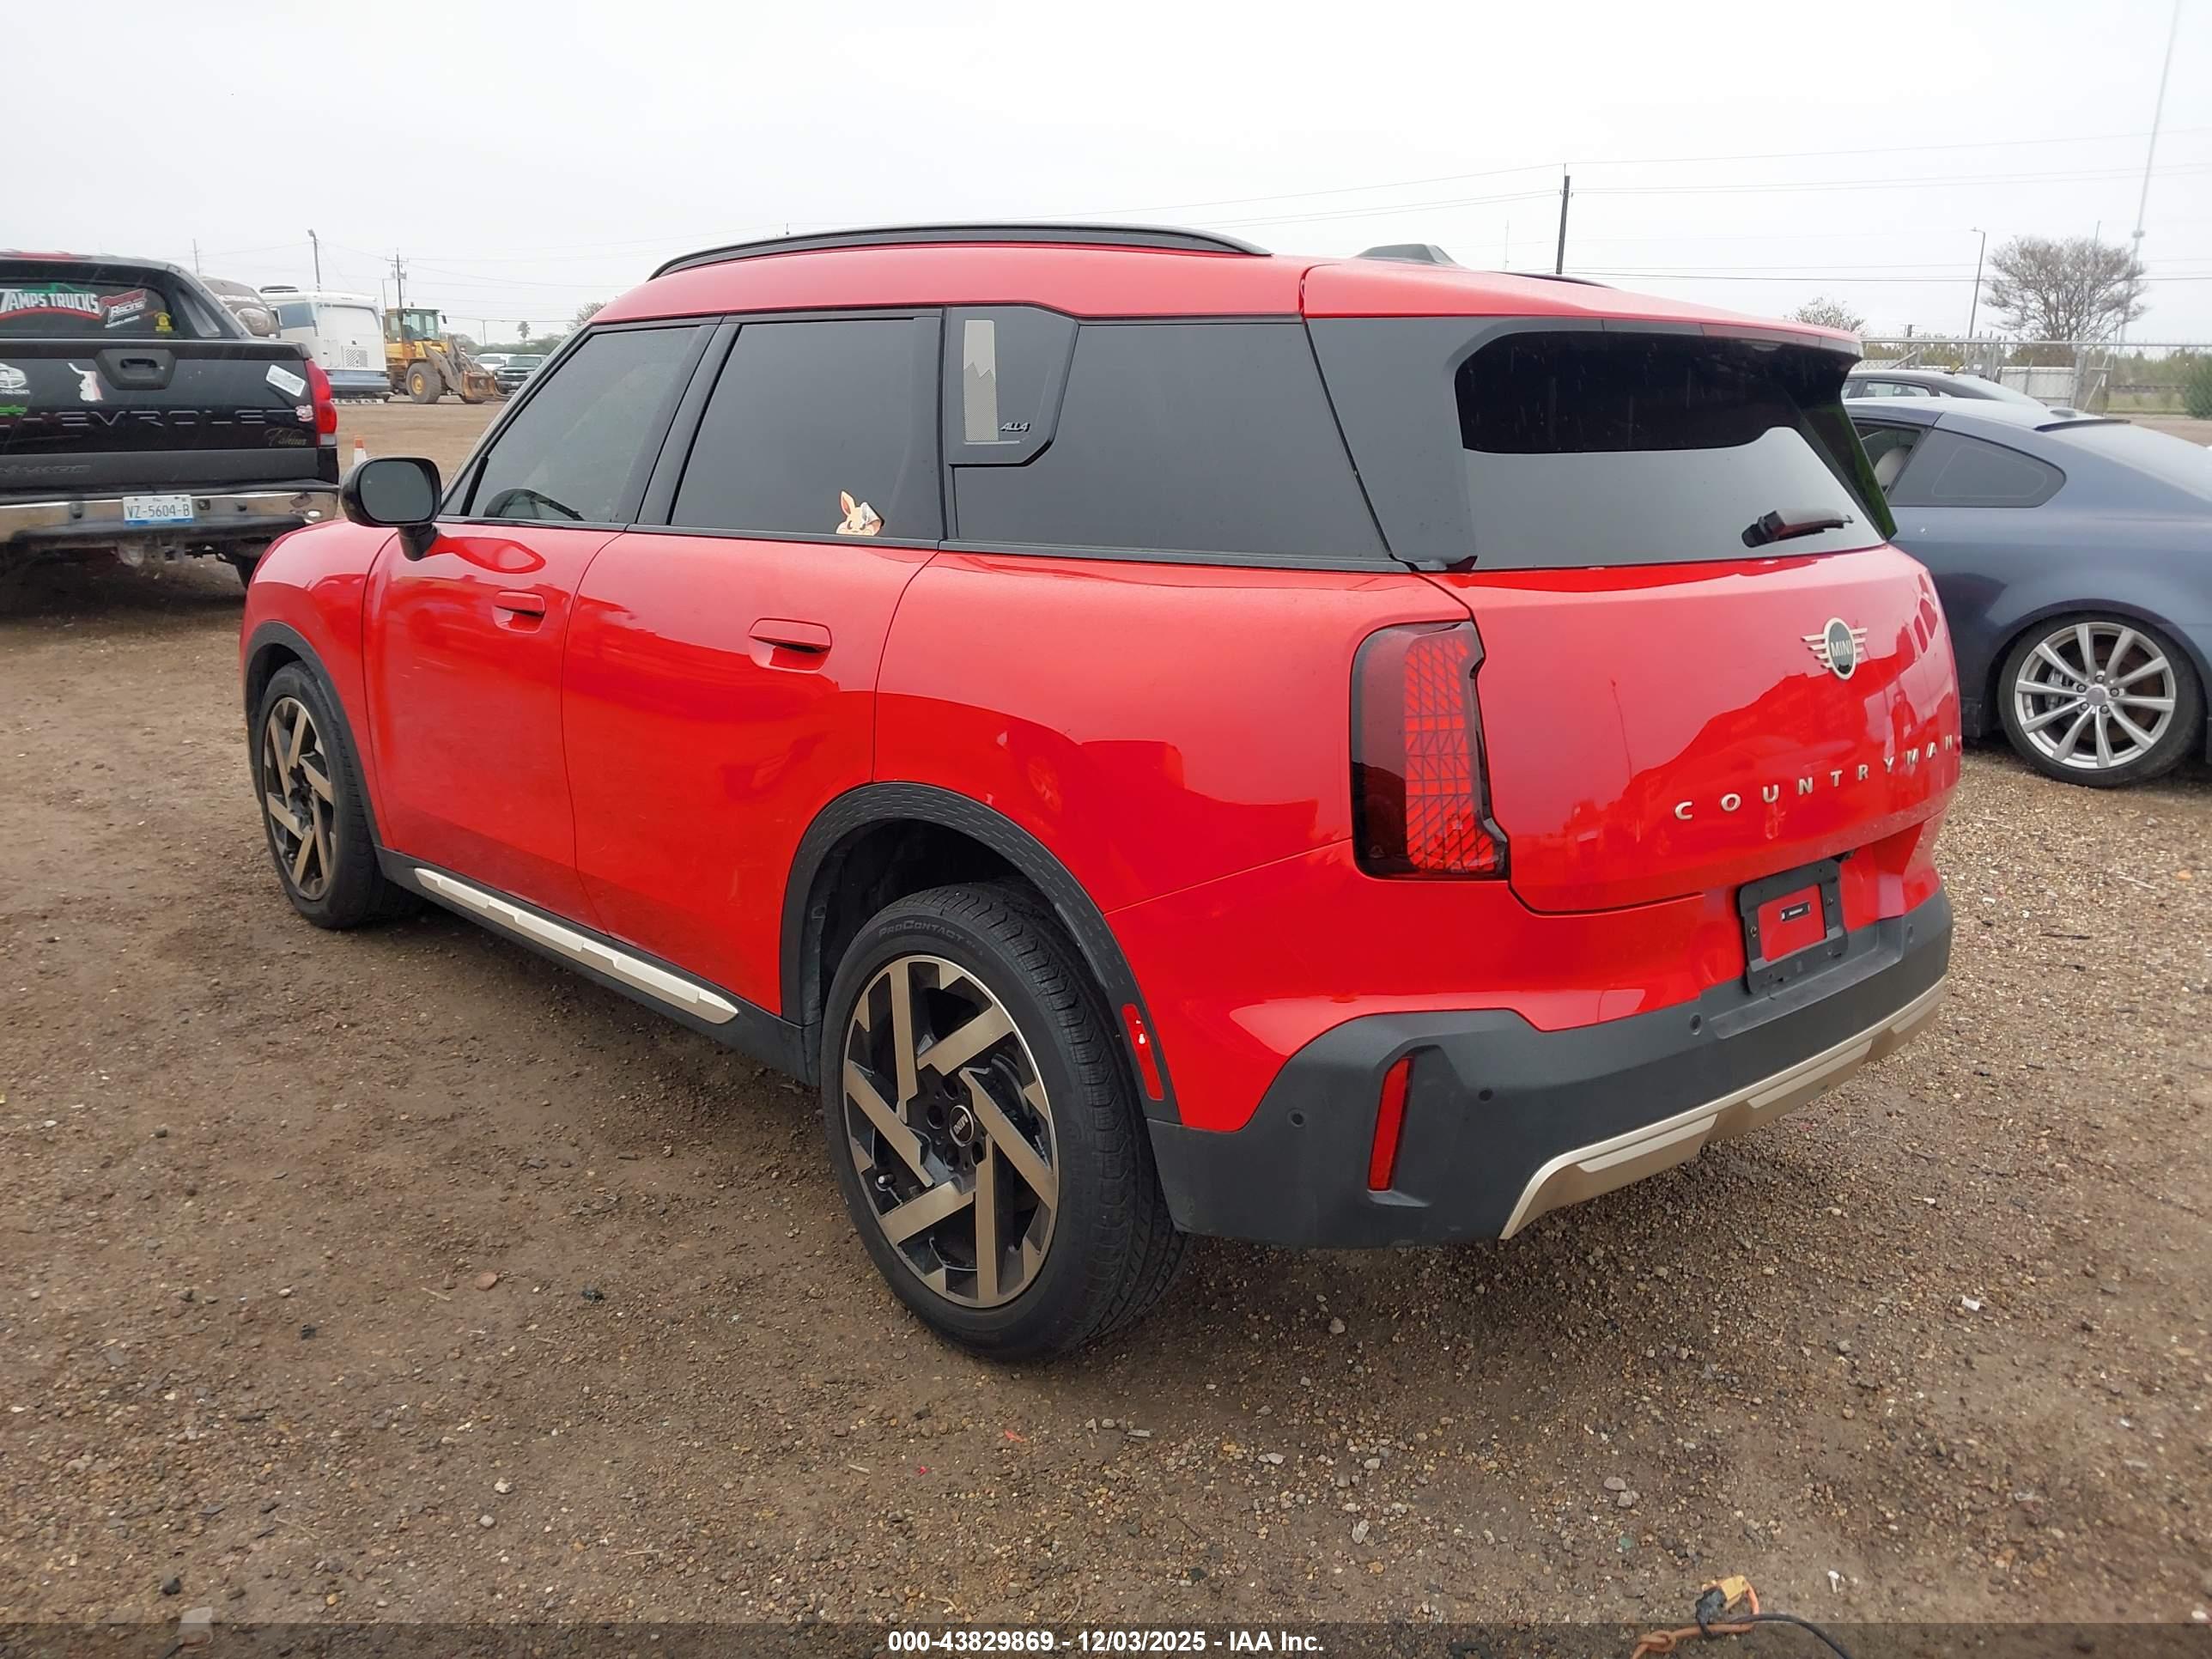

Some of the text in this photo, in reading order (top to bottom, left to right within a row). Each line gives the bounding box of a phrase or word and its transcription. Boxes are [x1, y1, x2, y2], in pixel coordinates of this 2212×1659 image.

[48, 293, 101, 316] TRUCKS
[999, 422, 1030, 433] ALL4
[126, 503, 191, 519] VZ-5604-B
[1831, 638, 1853, 658] MINI
[1674, 734, 1954, 821] COUNTRYMAN
